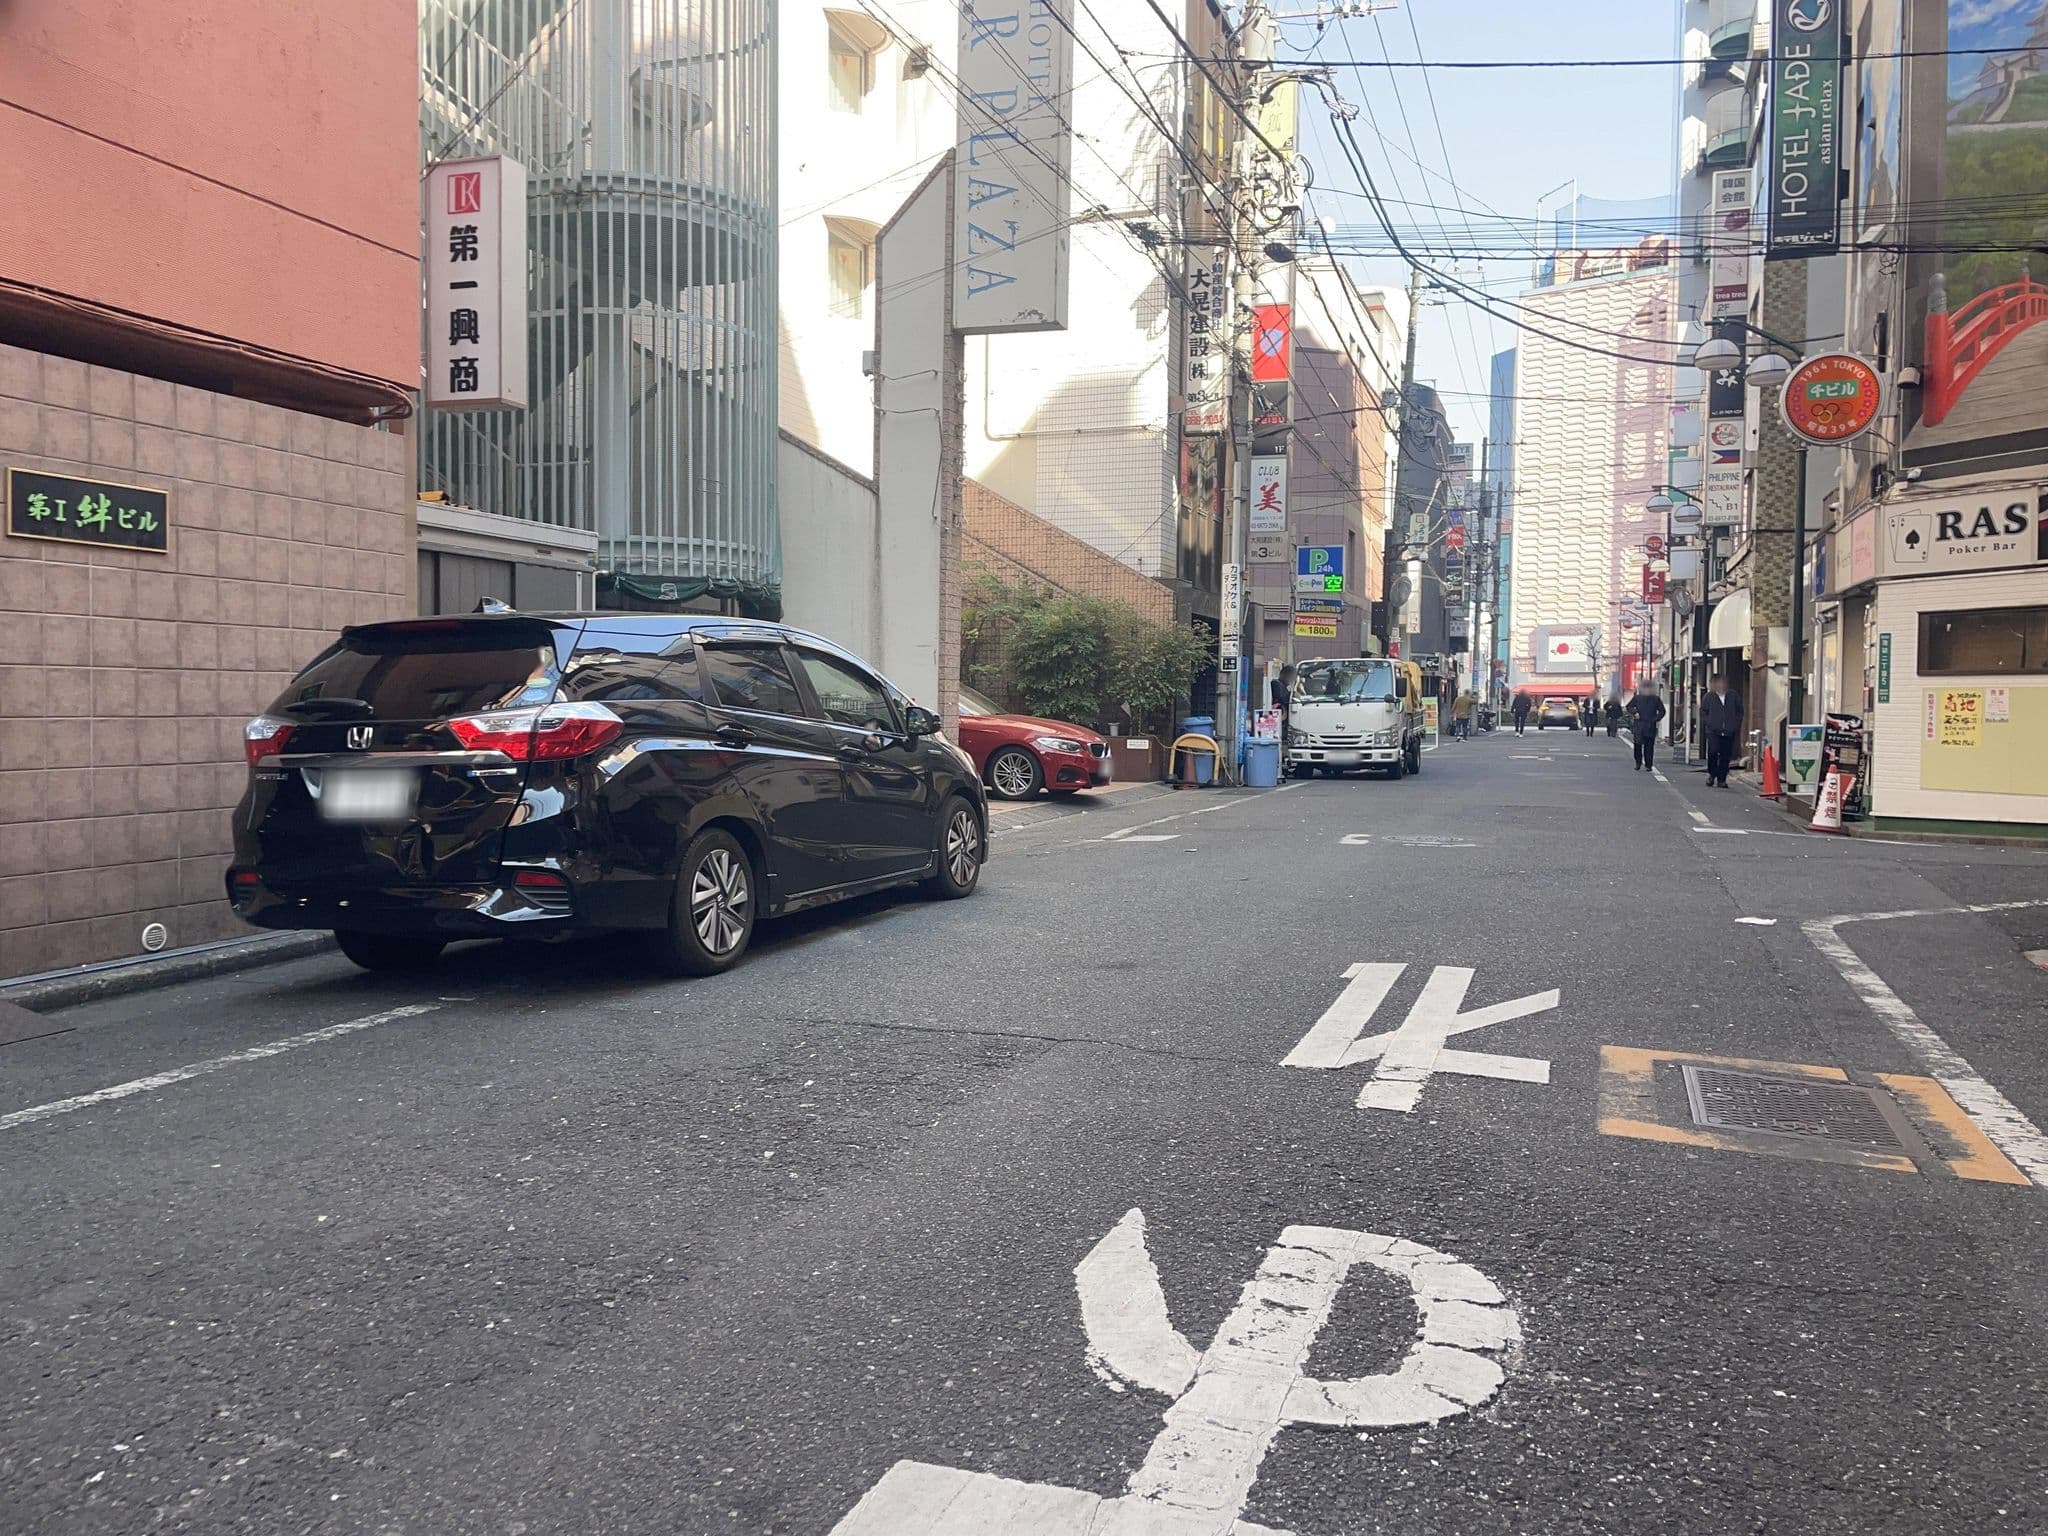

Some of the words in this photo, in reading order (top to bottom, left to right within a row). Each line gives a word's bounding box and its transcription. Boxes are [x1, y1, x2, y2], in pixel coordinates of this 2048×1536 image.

[1783, 43, 1816, 122] JADE
[1821, 79, 1833, 119] relax
[1819, 121, 1831, 164] asian
[1722, 178, 1745, 188] 韓国
[1781, 128, 1809, 217] HOTEL
[967, 85, 1019, 299] PLAZA
[1722, 192, 1745, 203] 会館
[449, 224, 480, 393] 第一興商
[1800, 363, 1827, 382] 1964
[1832, 360, 1866, 379] TOKYO
[1708, 471, 1740, 482] PHILIPPINE
[1726, 502, 1738, 511] B1
[1935, 502, 2029, 542] RAS
[1949, 545, 1987, 555] Poker
[1993, 542, 2017, 551] Bar
[1309, 548, 1329, 574] P
[1324, 574, 1343, 592] 空
[1309, 626, 1330, 634] 1800
